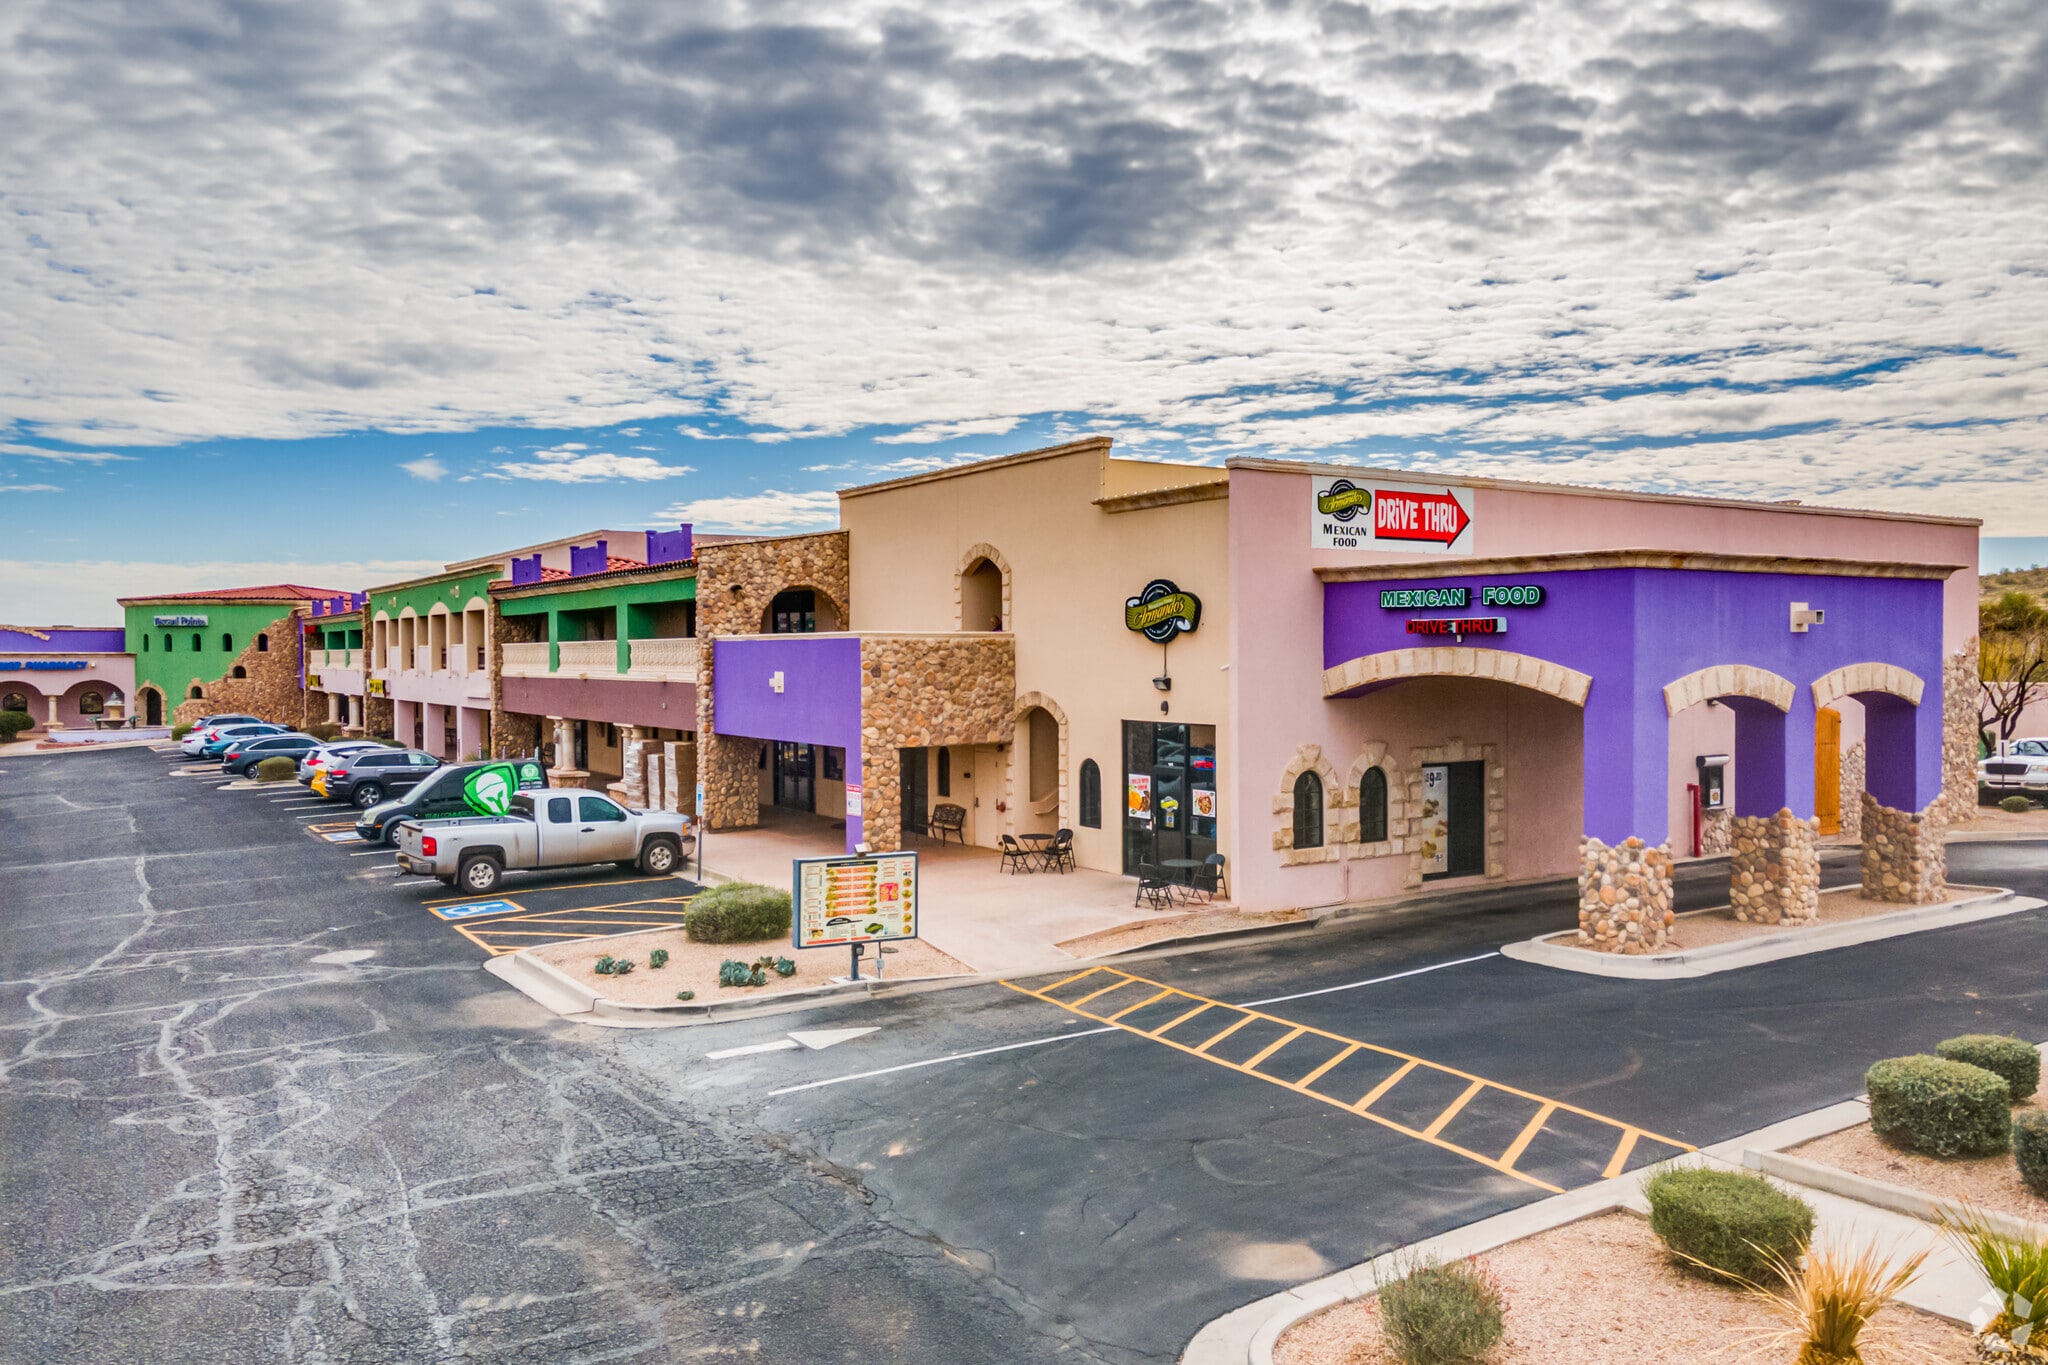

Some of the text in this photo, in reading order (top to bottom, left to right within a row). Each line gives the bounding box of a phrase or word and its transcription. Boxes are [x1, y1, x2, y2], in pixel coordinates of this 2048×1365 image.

[1421, 501, 1457, 533] THRU
[1333, 537, 1358, 547] FOOD
[1380, 586, 1541, 608] MEXICAN FOOD
[1405, 619, 1494, 634] DRIVE THRU
